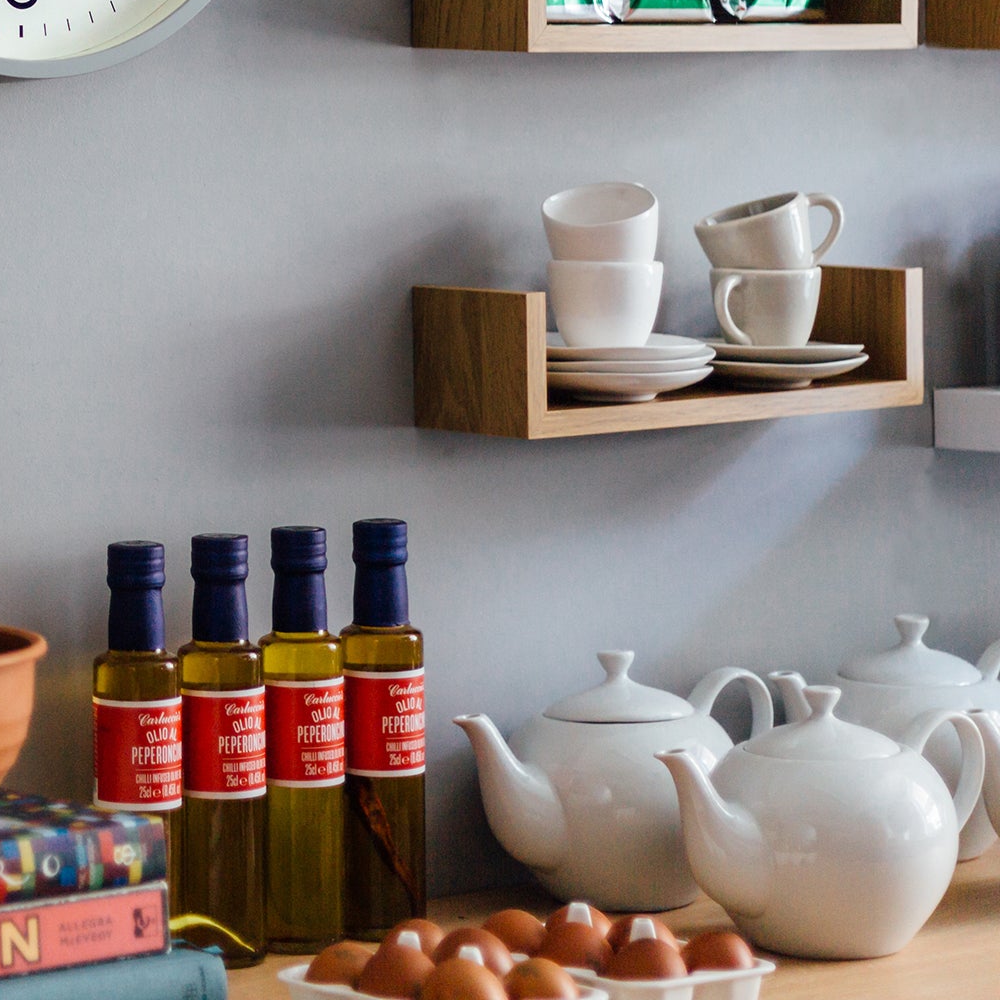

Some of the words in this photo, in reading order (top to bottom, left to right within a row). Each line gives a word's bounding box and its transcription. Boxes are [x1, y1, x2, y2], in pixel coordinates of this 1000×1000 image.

[388, 682, 425, 697] Carlucc
[395, 697, 415, 713] OLIO
[416, 698, 423, 711] AL
[311, 706, 332, 723] OLIO
[333, 706, 341, 720] AL
[382, 711, 425, 734] PEPERONC
[233, 716, 254, 733] OLIO
[255, 717, 262, 730] AL
[297, 720, 345, 743] PEPERONC
[146, 727, 168, 744] OLIO
[169, 727, 177, 742] AL
[218, 731, 266, 754] PEPERONC
[131, 741, 182, 765] PEPERONC
